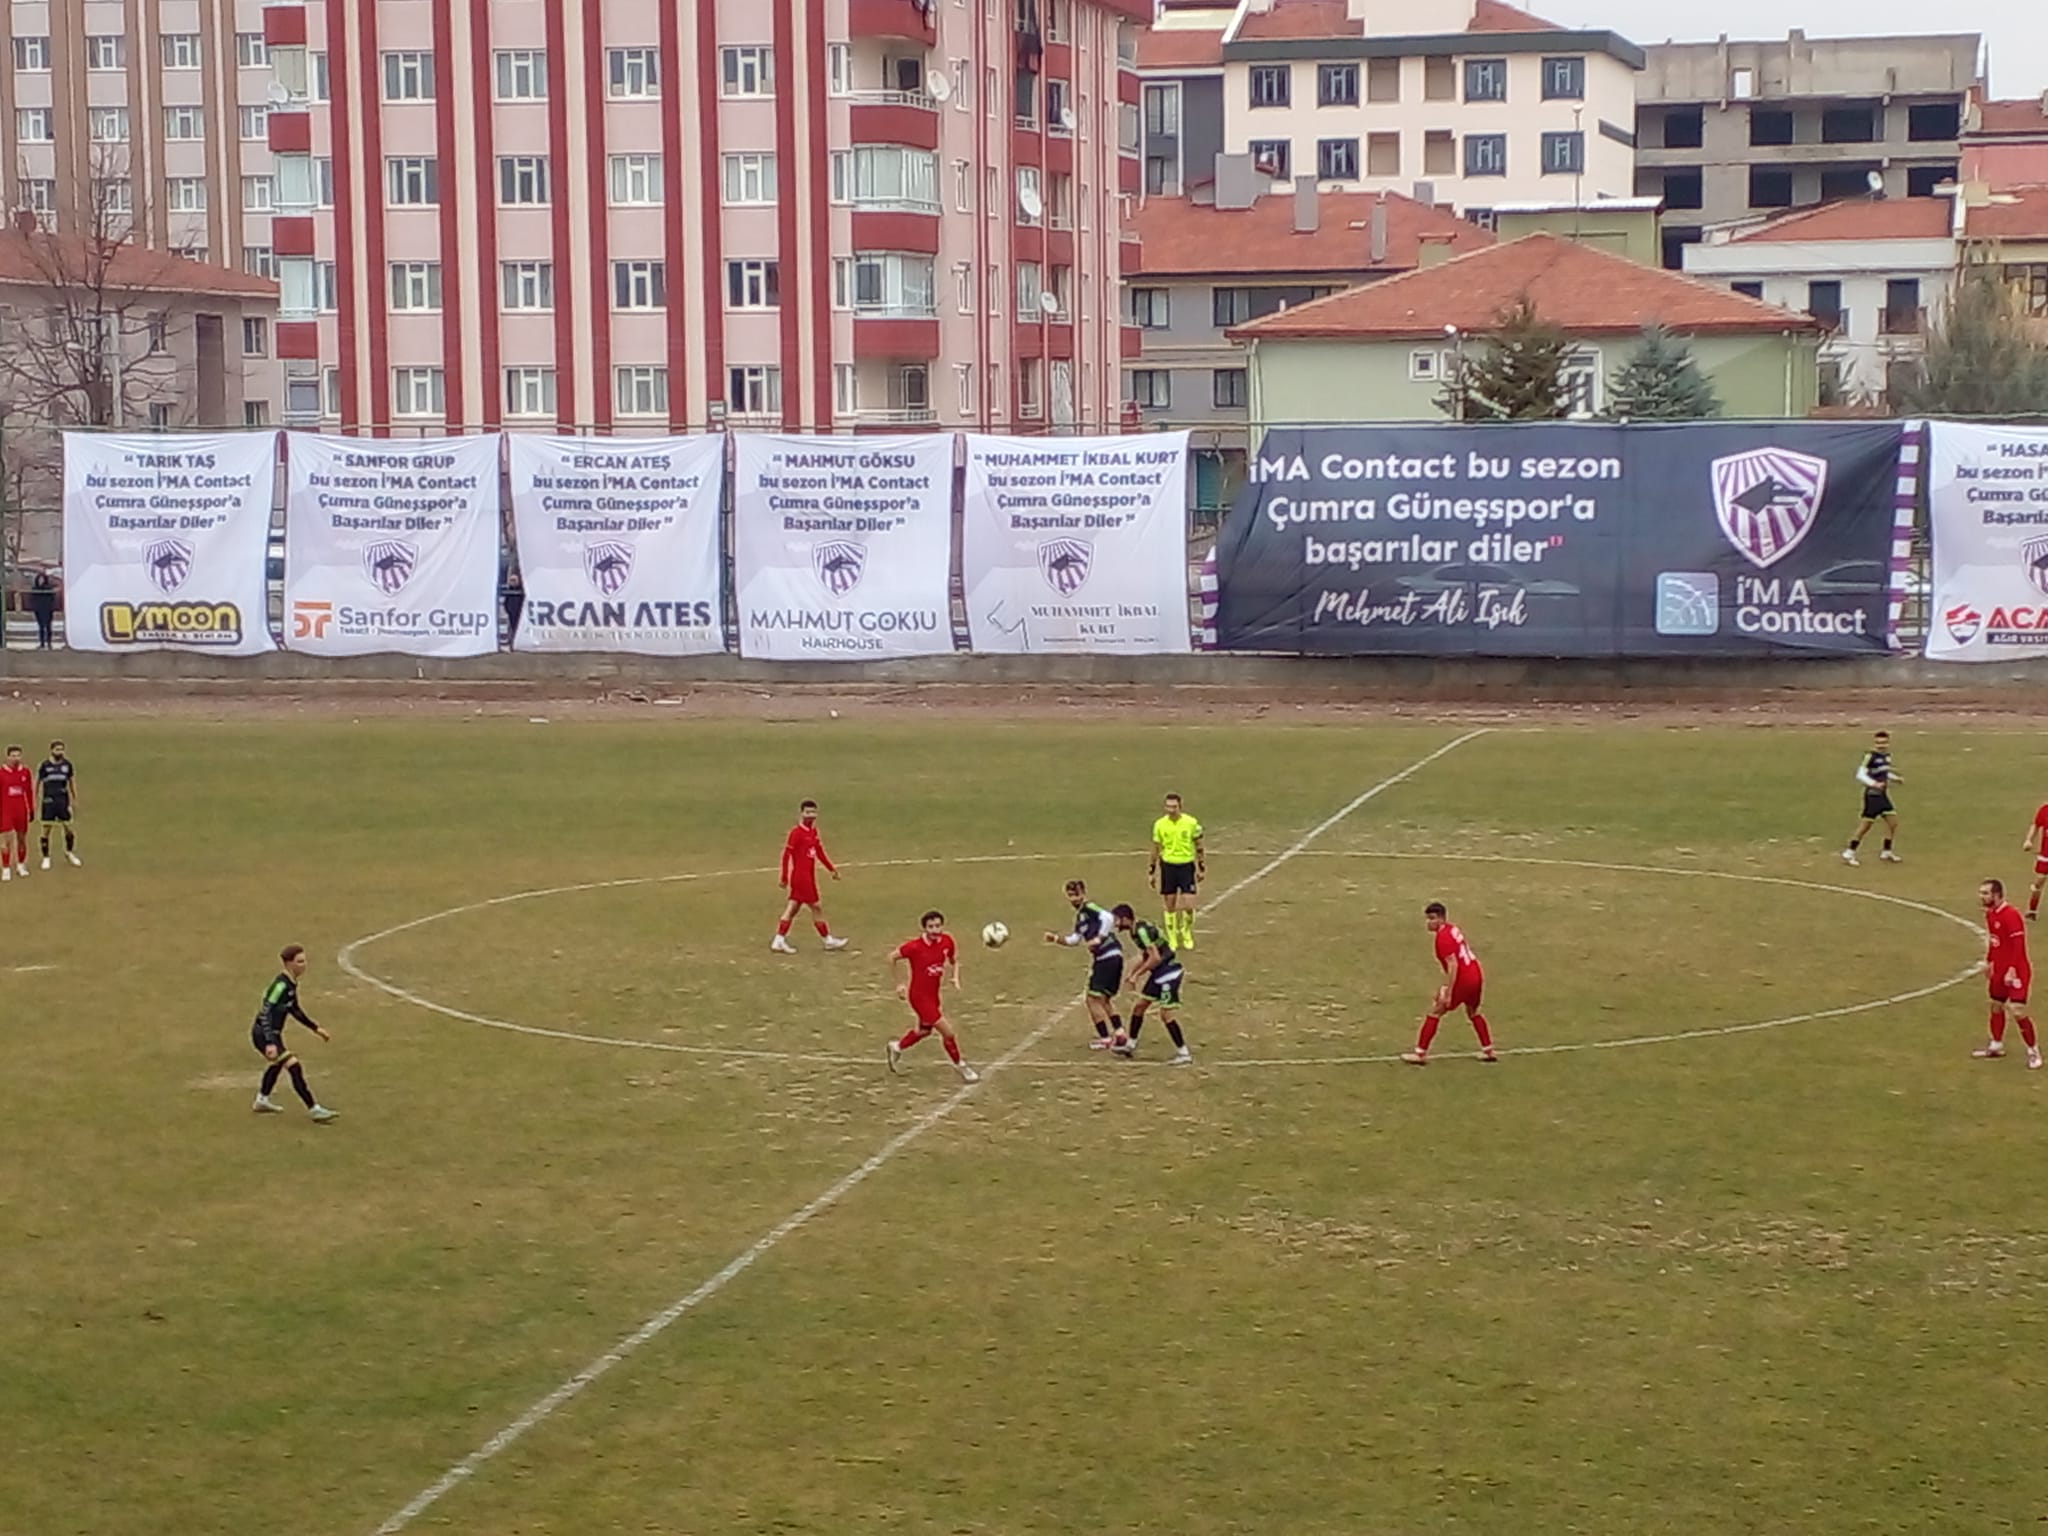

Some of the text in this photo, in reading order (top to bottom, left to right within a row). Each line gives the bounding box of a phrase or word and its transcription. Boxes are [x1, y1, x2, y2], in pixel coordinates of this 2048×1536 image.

[137, 455, 183, 467] TARIK
[186, 455, 215, 468] TAŞ
[346, 455, 409, 467] SANFOR
[413, 456, 455, 467] GRUP
[574, 456, 628, 468] ERCAN
[631, 456, 671, 470] ATEŞ
[786, 455, 855, 467] MAHMUT
[859, 453, 915, 468] GÖKSU
[986, 453, 1079, 466] MUHAMMET
[1083, 451, 1131, 465] İKBAL
[1136, 451, 1178, 464] KURT
[1321, 451, 1456, 480] Contact
[1469, 451, 1509, 480] bu
[1521, 456, 1621, 479] sezon
[1956, 465, 1979, 478] bu
[1983, 468, 2033, 479] sezon
[87, 474, 106, 487] bu
[110, 477, 153, 488] sezon
[195, 474, 251, 488] Contact
[310, 473, 329, 486] bu
[334, 477, 377, 488] sezon
[418, 476, 476, 488] Contact
[534, 475, 551, 488] bu
[556, 478, 600, 488] sezon
[640, 476, 699, 488] Contact
[759, 475, 778, 488] bu
[782, 477, 827, 488] sezon
[869, 476, 929, 489] Contact
[988, 474, 1007, 486] bu
[1011, 476, 1056, 486] sezon
[1099, 473, 1161, 485] Contact
[96, 496, 145, 509] Çumra
[319, 494, 369, 508] Çumra
[998, 494, 1047, 509] Çumra
[1967, 488, 2023, 503] Çumra
[543, 497, 592, 510] Çumra
[769, 496, 819, 510] Çumra
[1268, 497, 1375, 530] Çumra
[1306, 535, 1458, 571] başarılar
[1314, 590, 1419, 625] Mehmet
[1421, 589, 1468, 622] Ali
[339, 608, 421, 627] Sanfor
[429, 609, 488, 635] Grup
[751, 610, 854, 630] MAHMUT
[1737, 606, 1866, 634] Contact
